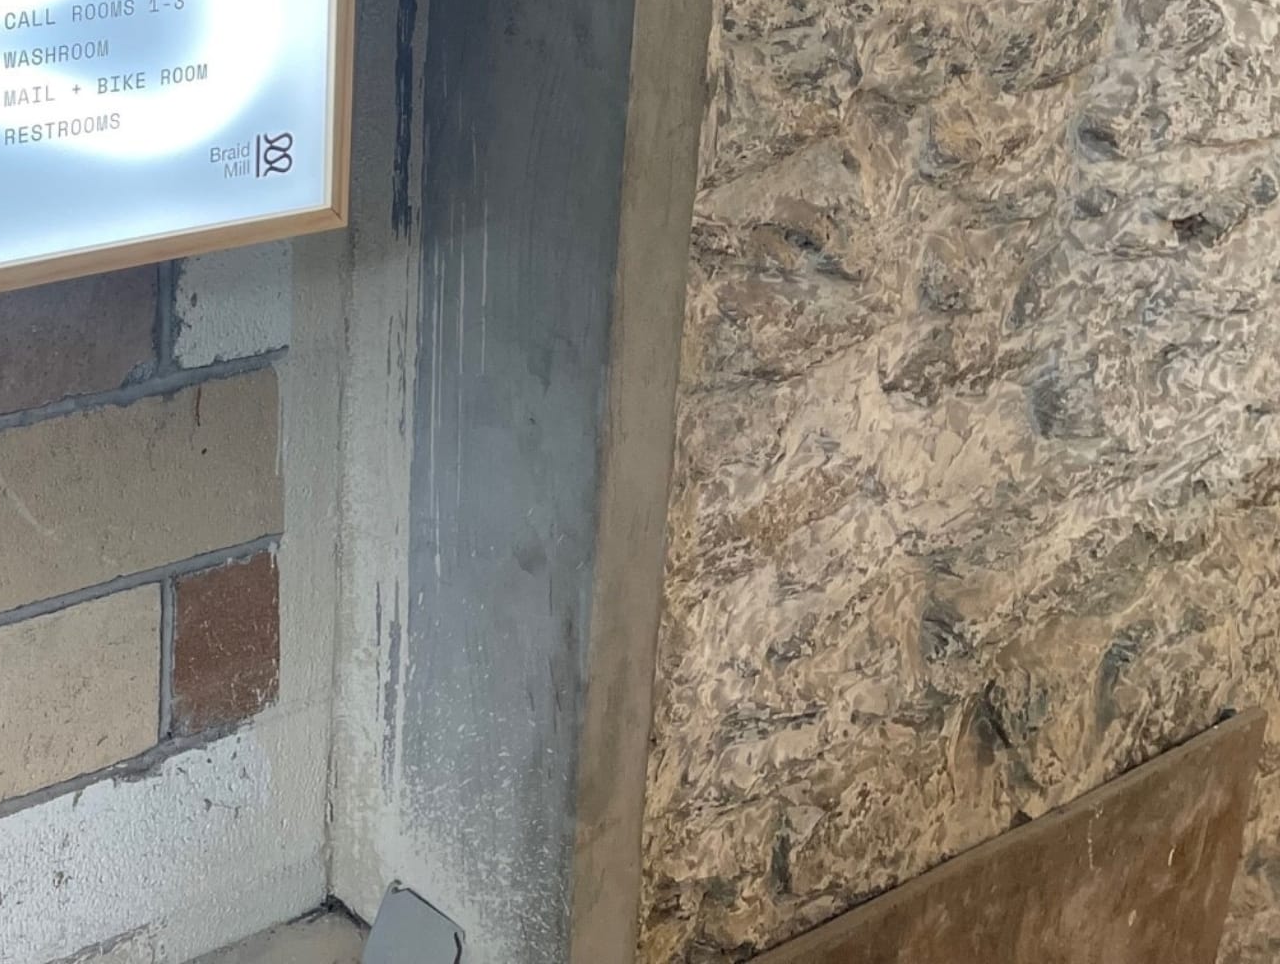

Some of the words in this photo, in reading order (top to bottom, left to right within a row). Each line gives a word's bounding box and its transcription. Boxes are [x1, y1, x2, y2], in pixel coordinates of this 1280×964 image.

[4, 5, 56, 30] CALL
[4, 40, 108, 69] WASHROOM
[4, 85, 55, 107] MAIL
[98, 72, 145, 94] BIKE
[161, 64, 207, 85] ROOM
[5, 113, 120, 145] RESTROOMS
[210, 142, 250, 163] Braid
[224, 160, 250, 179] Mill
